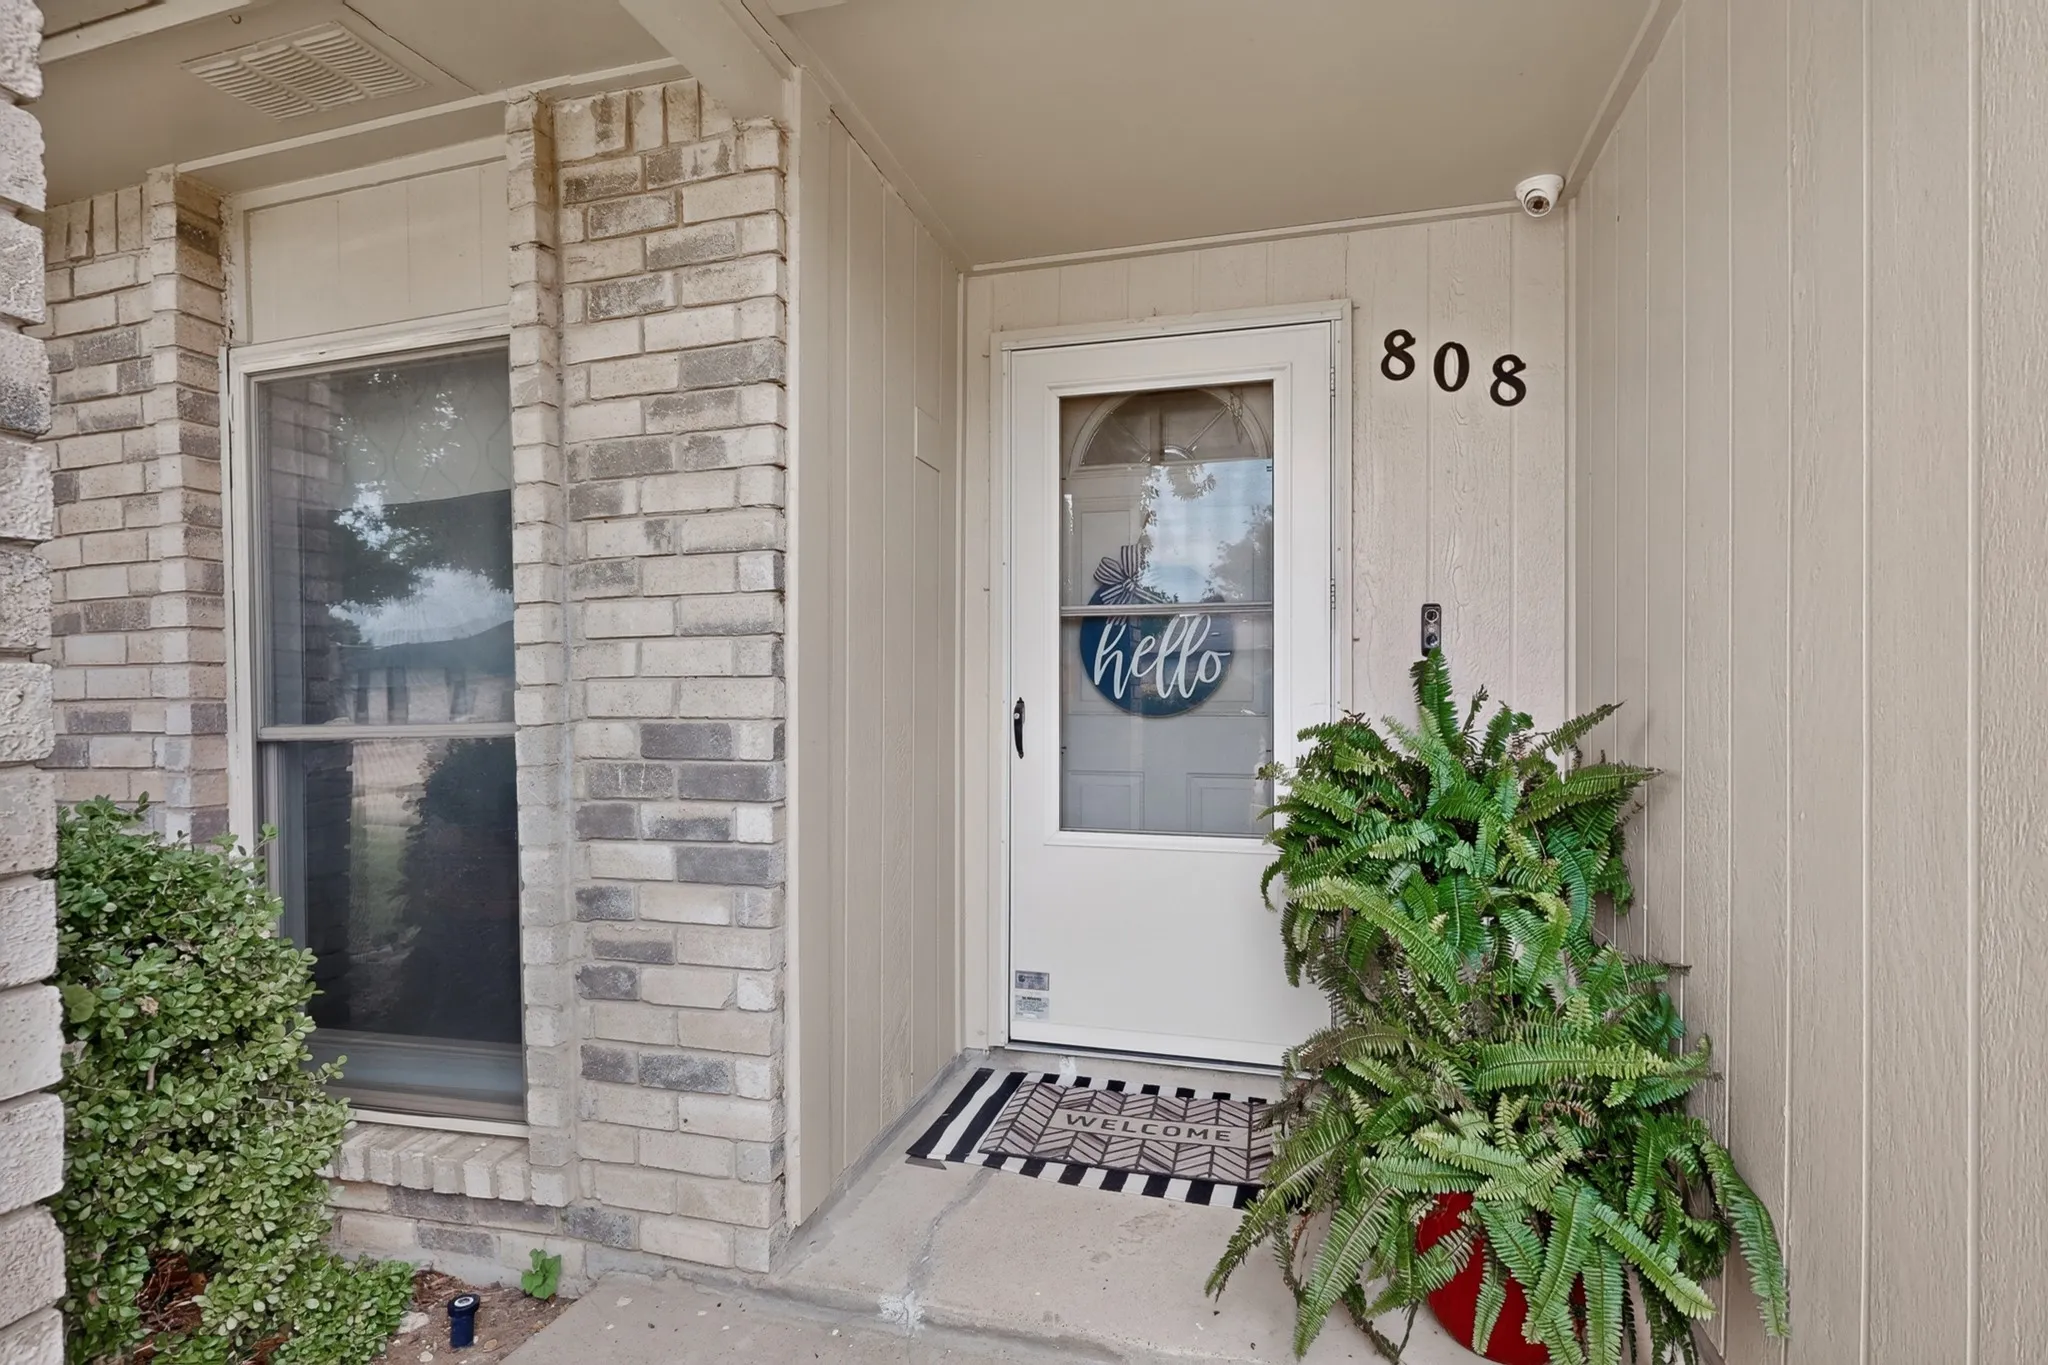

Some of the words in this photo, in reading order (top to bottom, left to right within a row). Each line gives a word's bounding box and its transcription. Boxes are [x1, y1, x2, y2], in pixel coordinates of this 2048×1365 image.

[1380, 329, 1527, 407] 808
[1093, 614, 1231, 699] hello
[1065, 1113, 1232, 1142] WELCOME
